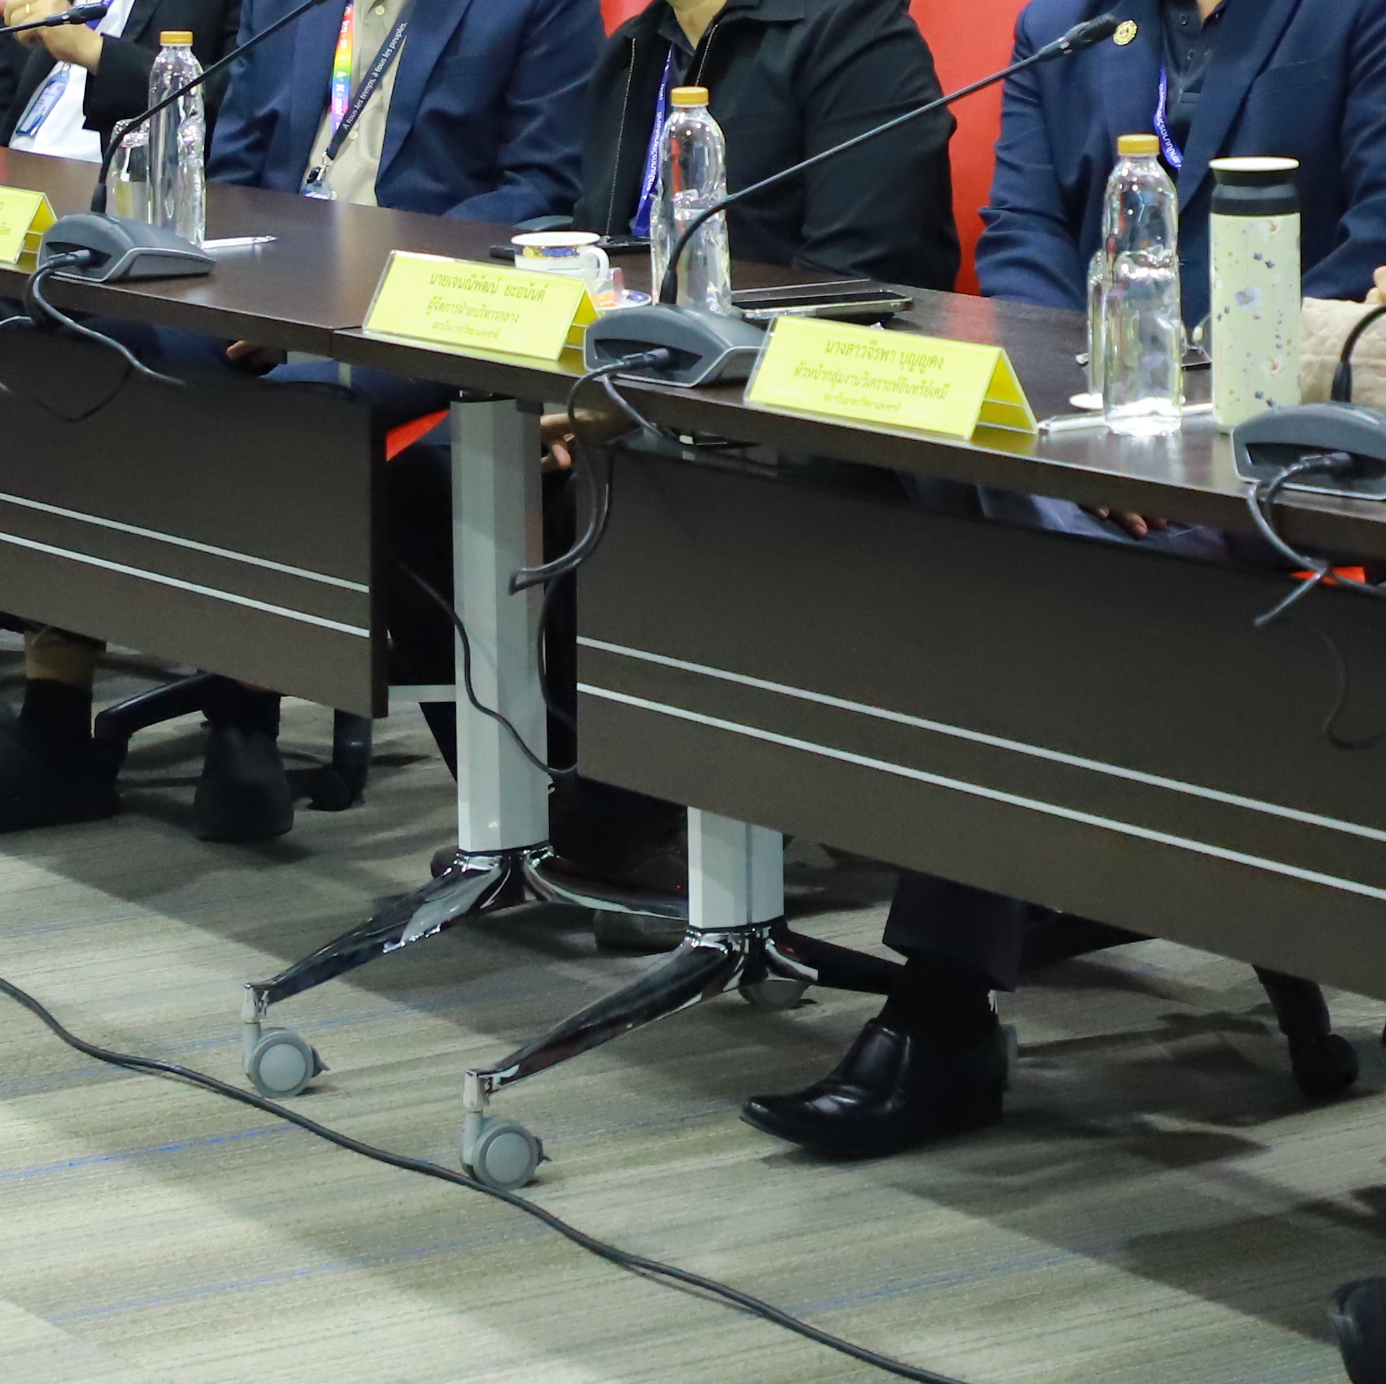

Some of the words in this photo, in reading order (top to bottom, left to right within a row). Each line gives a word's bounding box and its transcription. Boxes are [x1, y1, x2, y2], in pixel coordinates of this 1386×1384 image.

[336, 71, 348, 79] A
[354, 99, 364, 110] les
[375, 56, 387, 73] tous
[382, 48, 392, 59] les
[336, 84, 346, 93] K
[825, 340, 898, 364] นางสาวจีรพา
